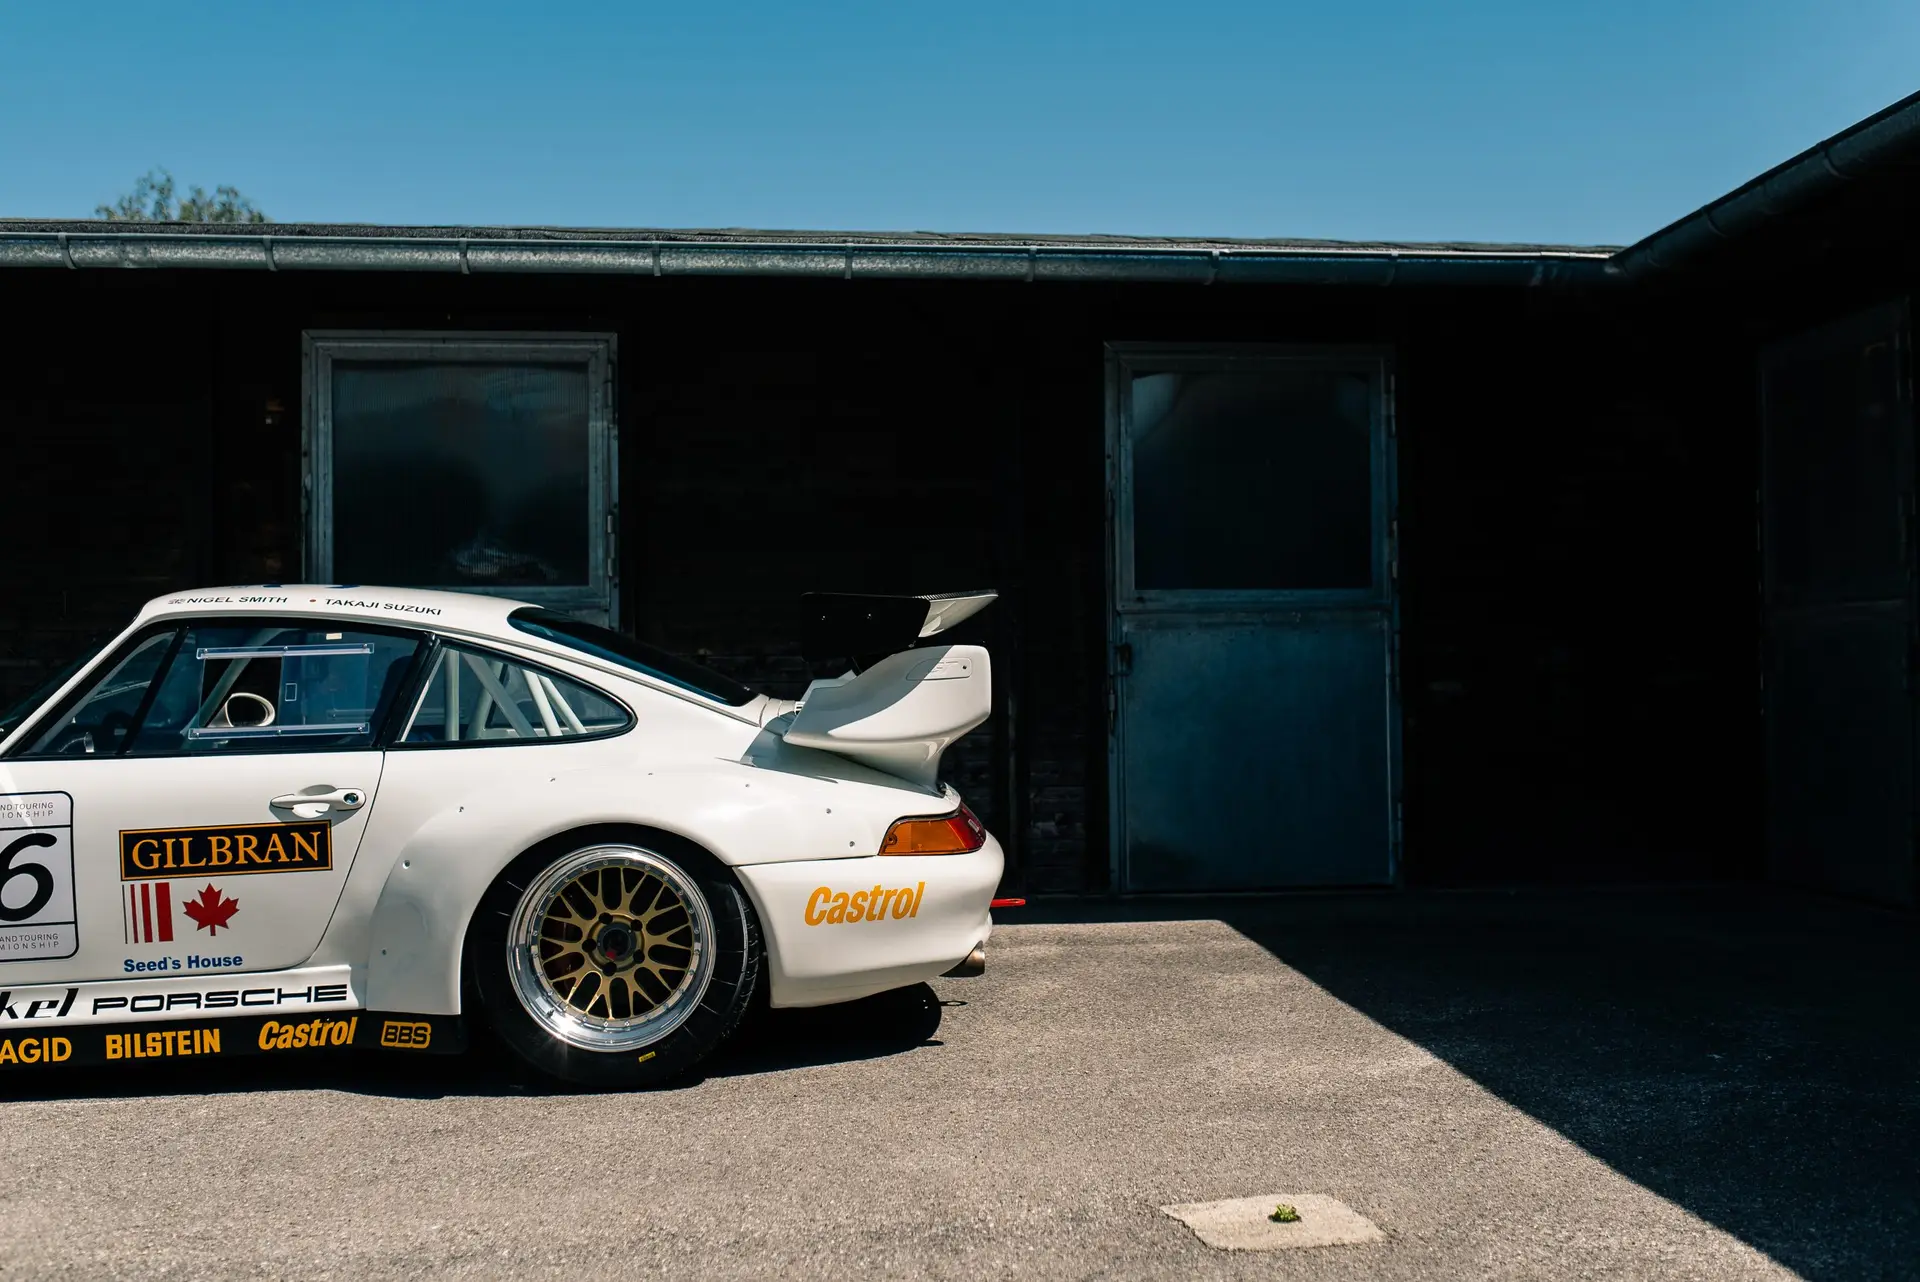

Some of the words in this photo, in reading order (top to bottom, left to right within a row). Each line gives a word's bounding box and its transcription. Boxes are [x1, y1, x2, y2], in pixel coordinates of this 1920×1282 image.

[325, 598, 380, 608] TAKAJI
[383, 602, 442, 616] SUZUKI
[2, 810, 54, 819] IONSHIP
[14, 802, 54, 810] TOURING
[131, 831, 322, 870] GILBRAN
[0, 832, 58, 922] 6
[804, 881, 925, 926] Castrol
[19, 933, 59, 941] TOURING
[187, 954, 243, 969] House
[92, 983, 348, 1015] PORSCHE
[106, 1029, 221, 1060] BILSTEIN
[258, 1017, 358, 1050] Castrol
[381, 1021, 431, 1048] BBS
[0, 1037, 72, 1064] AGID
